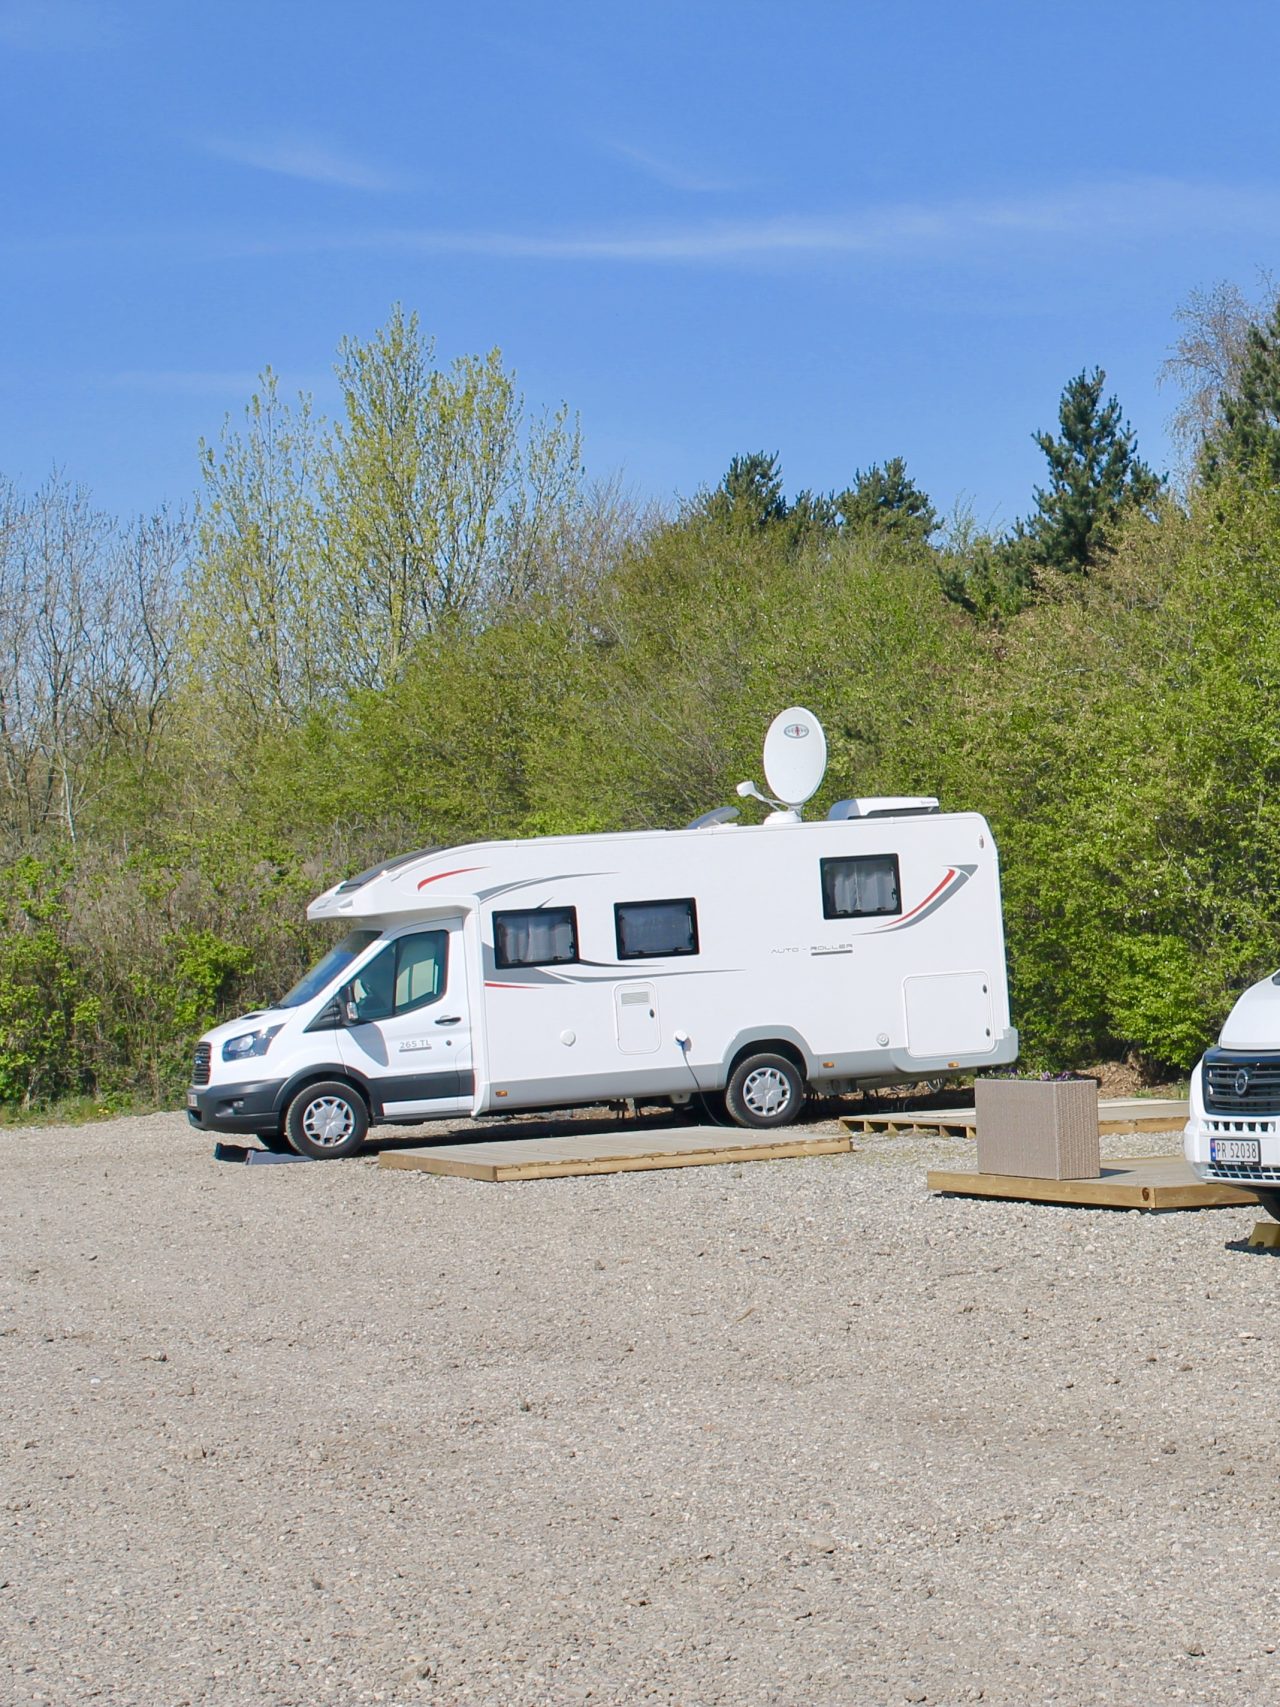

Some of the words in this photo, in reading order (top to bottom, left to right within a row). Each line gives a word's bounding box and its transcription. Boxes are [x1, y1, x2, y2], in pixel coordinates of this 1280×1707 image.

[810, 943, 853, 951] ROLLER
[400, 1040, 417, 1049] 265
[420, 1039, 431, 1047] TL
[1216, 1142, 1226, 1159] PR
[1230, 1142, 1257, 1159] 52038
